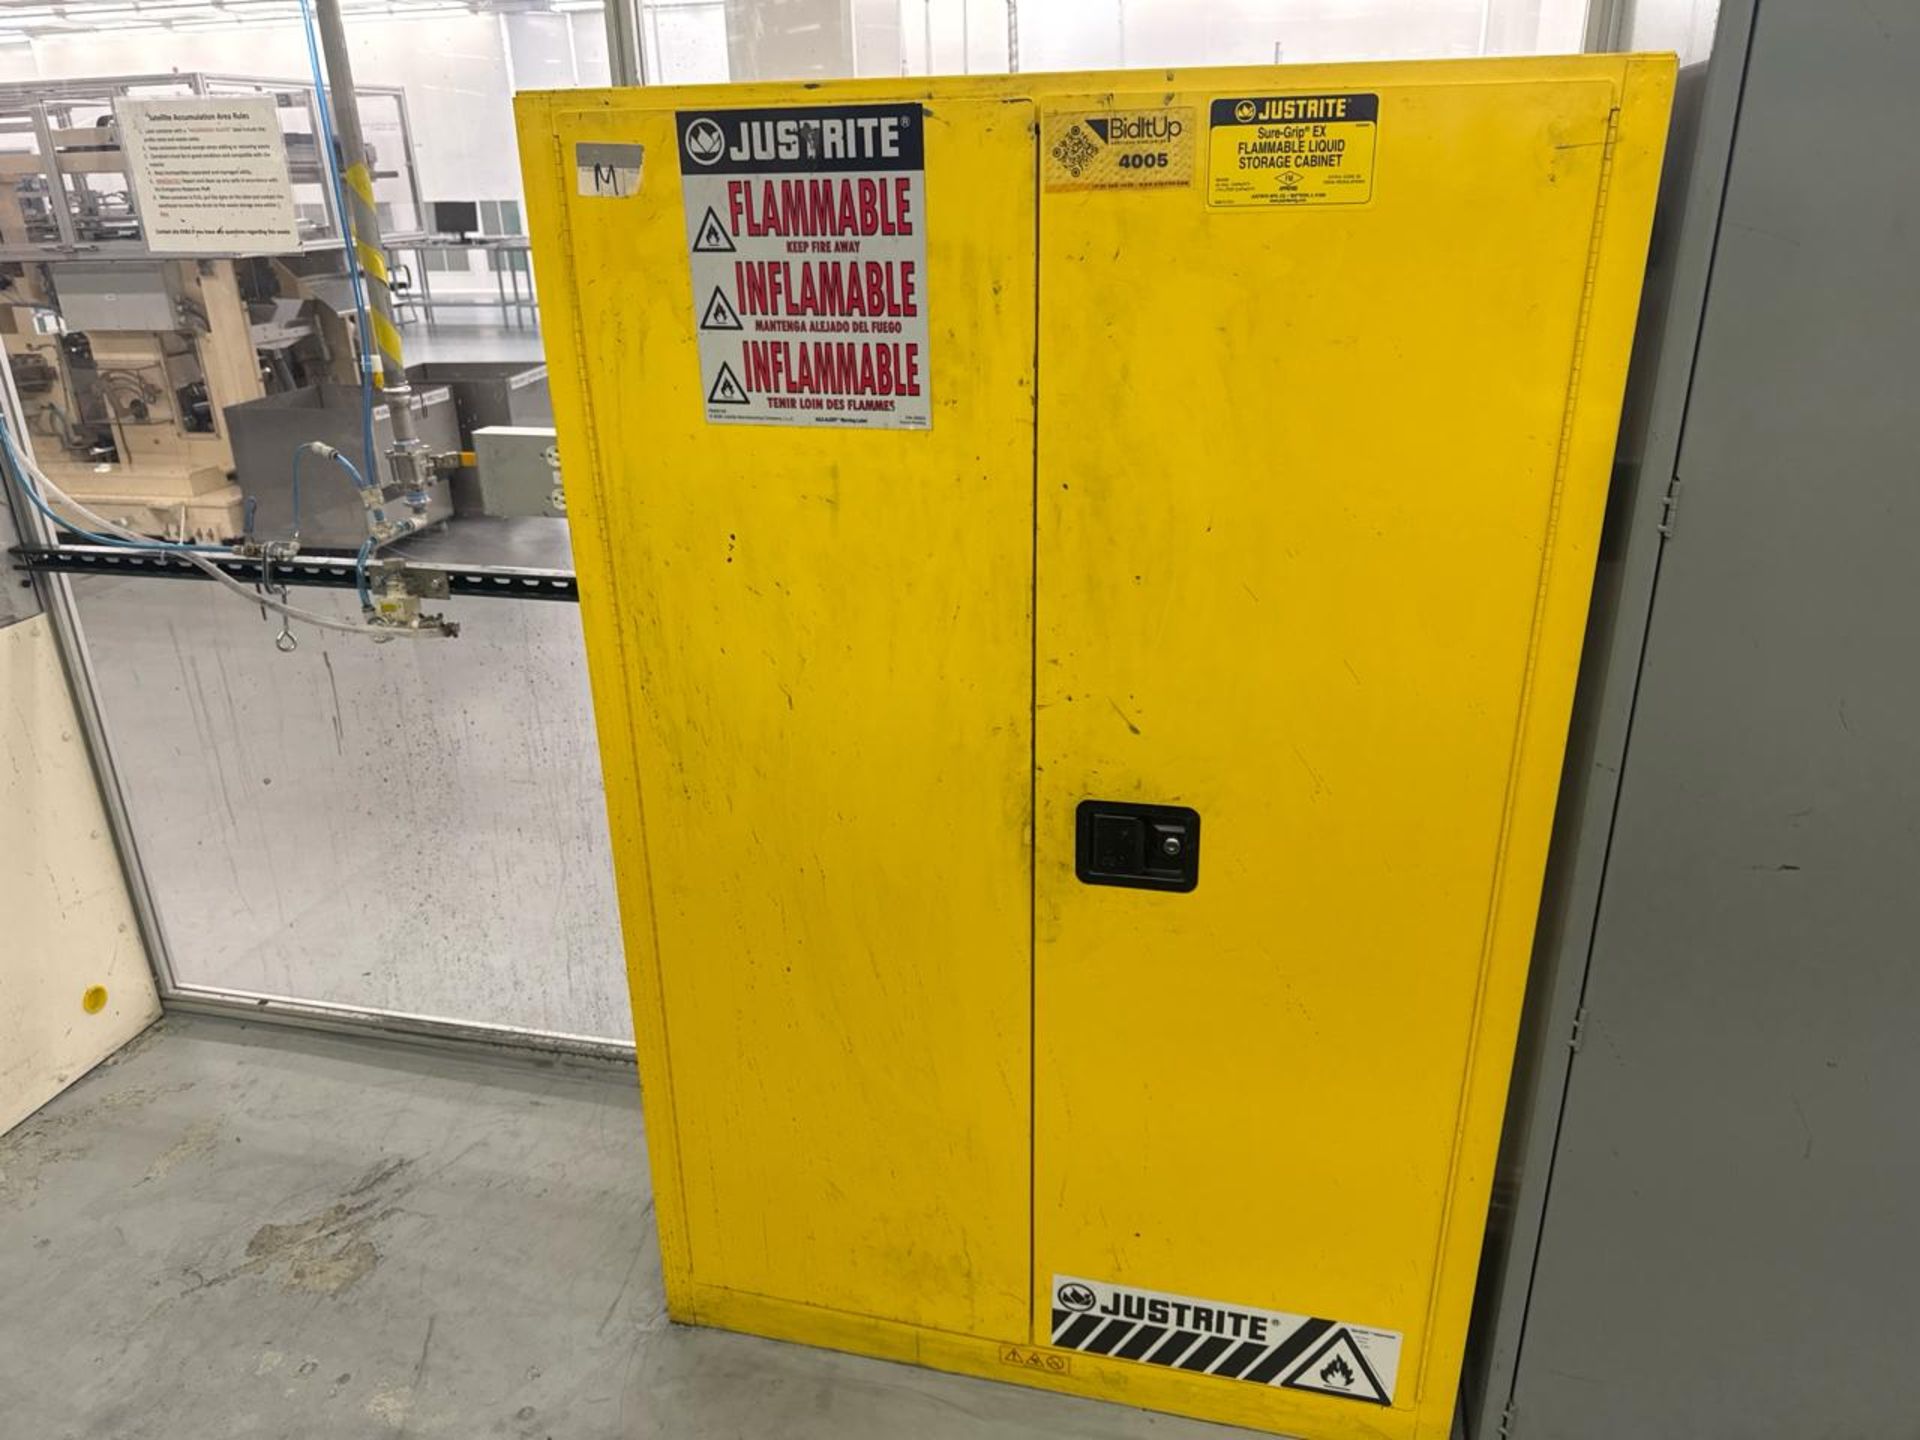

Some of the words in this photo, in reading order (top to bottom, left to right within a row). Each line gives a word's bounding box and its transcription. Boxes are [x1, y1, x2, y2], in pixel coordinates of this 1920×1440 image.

[173, 112, 215, 121] Accumulation
[217, 112, 231, 120] Area
[1110, 115, 1182, 143] BidItUp
[1312, 125, 1327, 138] EX
[1237, 140, 1306, 155] FLAMMABLE
[1308, 138, 1346, 153] LIQUID
[1118, 152, 1169, 169] 4005
[1238, 155, 1291, 170] STORAGE
[1294, 153, 1343, 169] CABINET
[594, 162, 619, 196] M
[727, 177, 913, 238] FLAMMABLE
[786, 241, 810, 253] KEEP
[811, 240, 832, 253] FIRE
[834, 240, 861, 253] AWAY
[734, 260, 918, 317] INFLAMABLE
[755, 319, 808, 332] MANTENGA
[809, 320, 851, 333] ALEJADO
[852, 320, 869, 333] DEL
[871, 321, 902, 334] FUEGO
[742, 340, 921, 397] INFLAMMABLE
[767, 397, 797, 410] TENIR
[799, 398, 825, 410] LOIN
[826, 398, 845, 411] DES
[847, 399, 896, 412] FLAMMES
